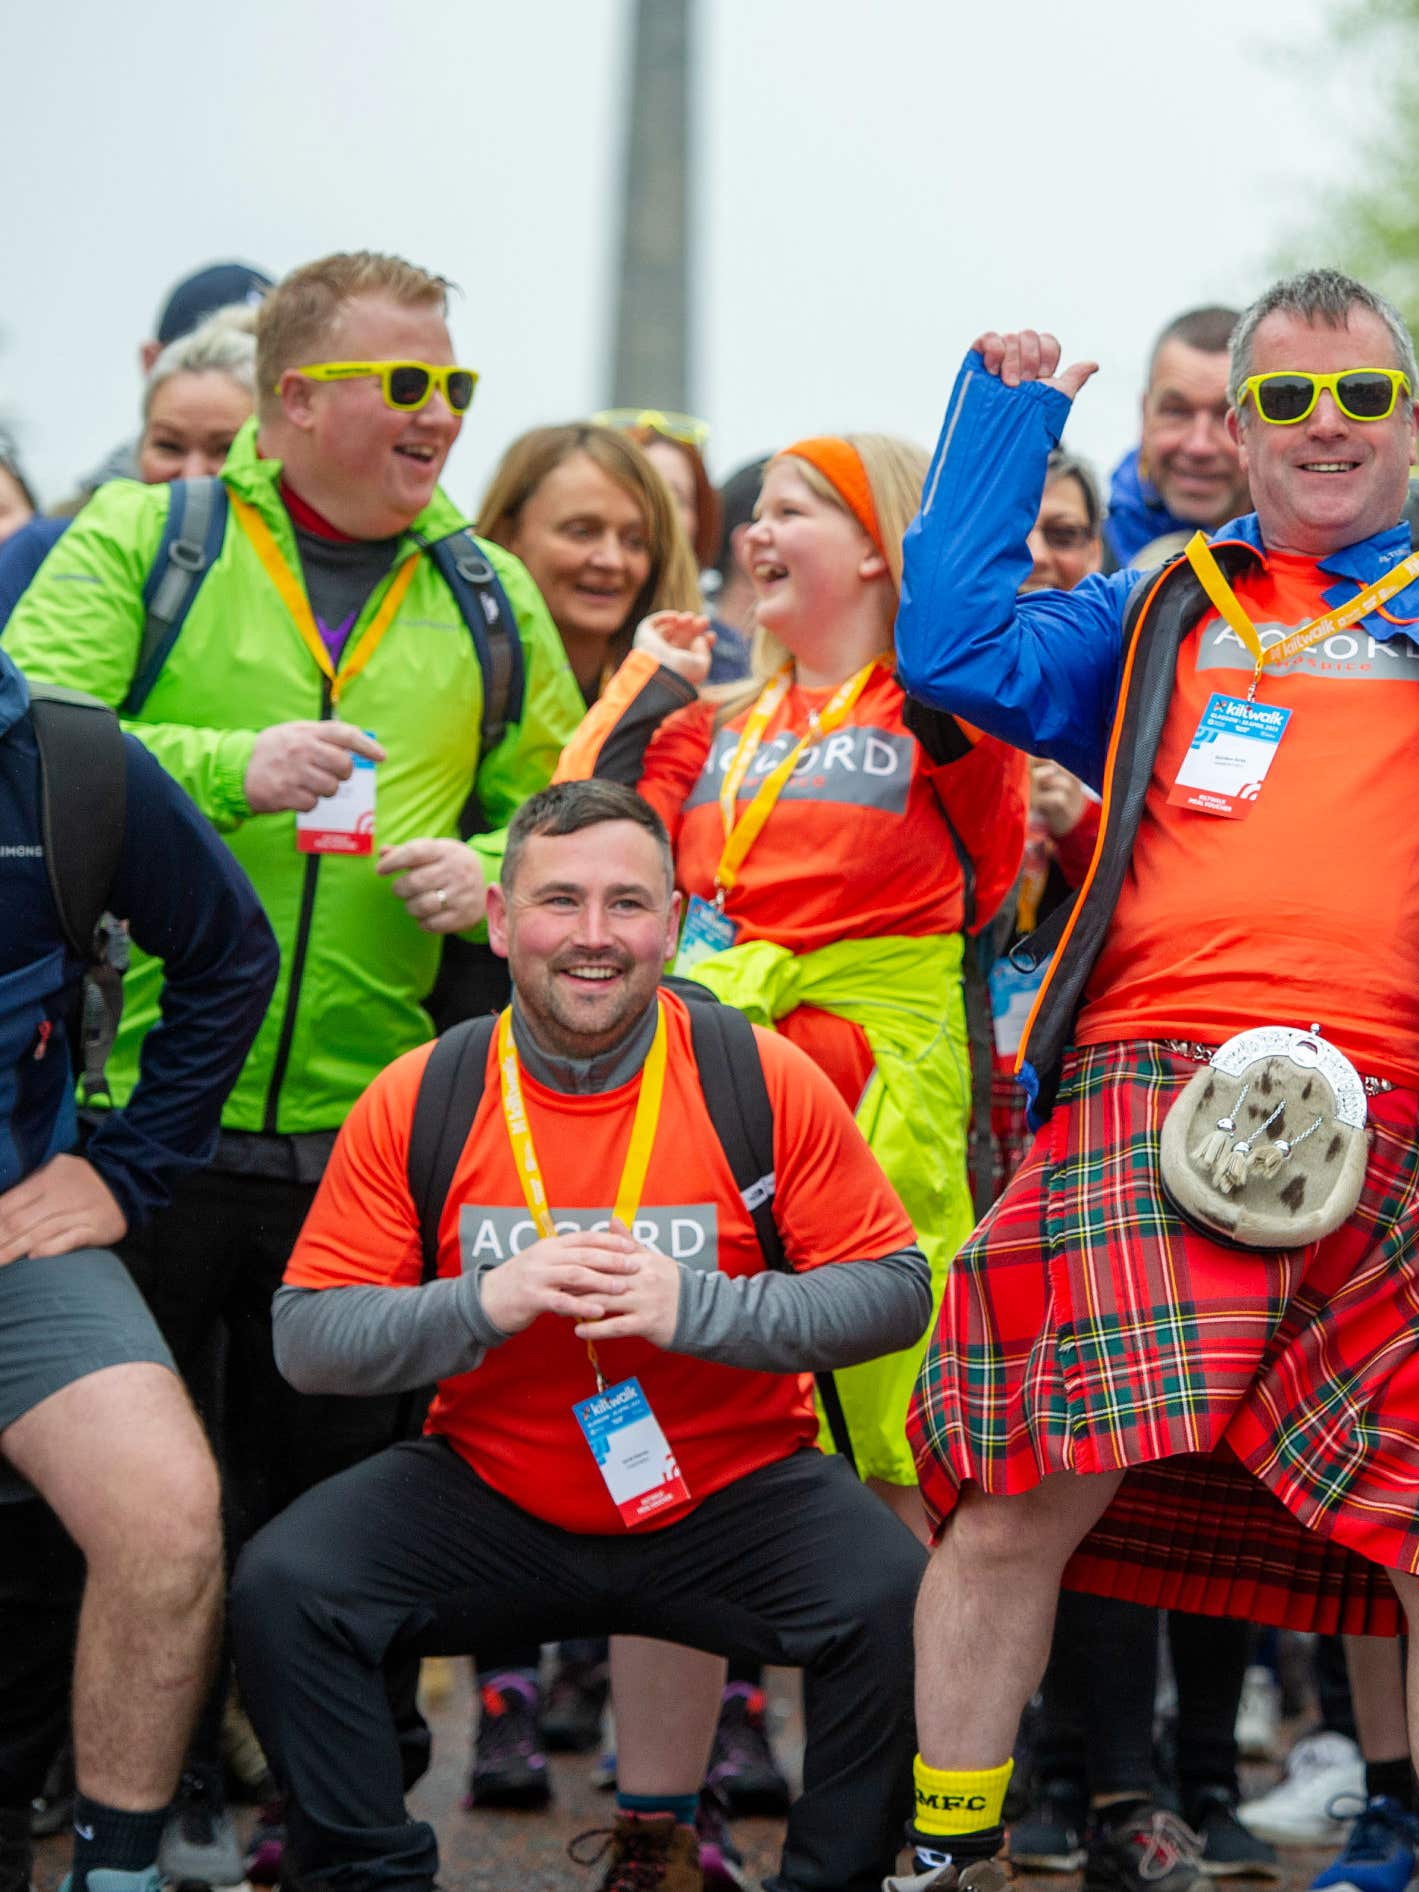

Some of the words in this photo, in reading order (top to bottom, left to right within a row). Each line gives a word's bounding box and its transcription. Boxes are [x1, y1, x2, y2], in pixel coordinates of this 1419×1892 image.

[1283, 617, 1335, 657] kiltwalk
[1226, 701, 1284, 725] kiltwalk
[472, 1218, 706, 1259] ACRD
